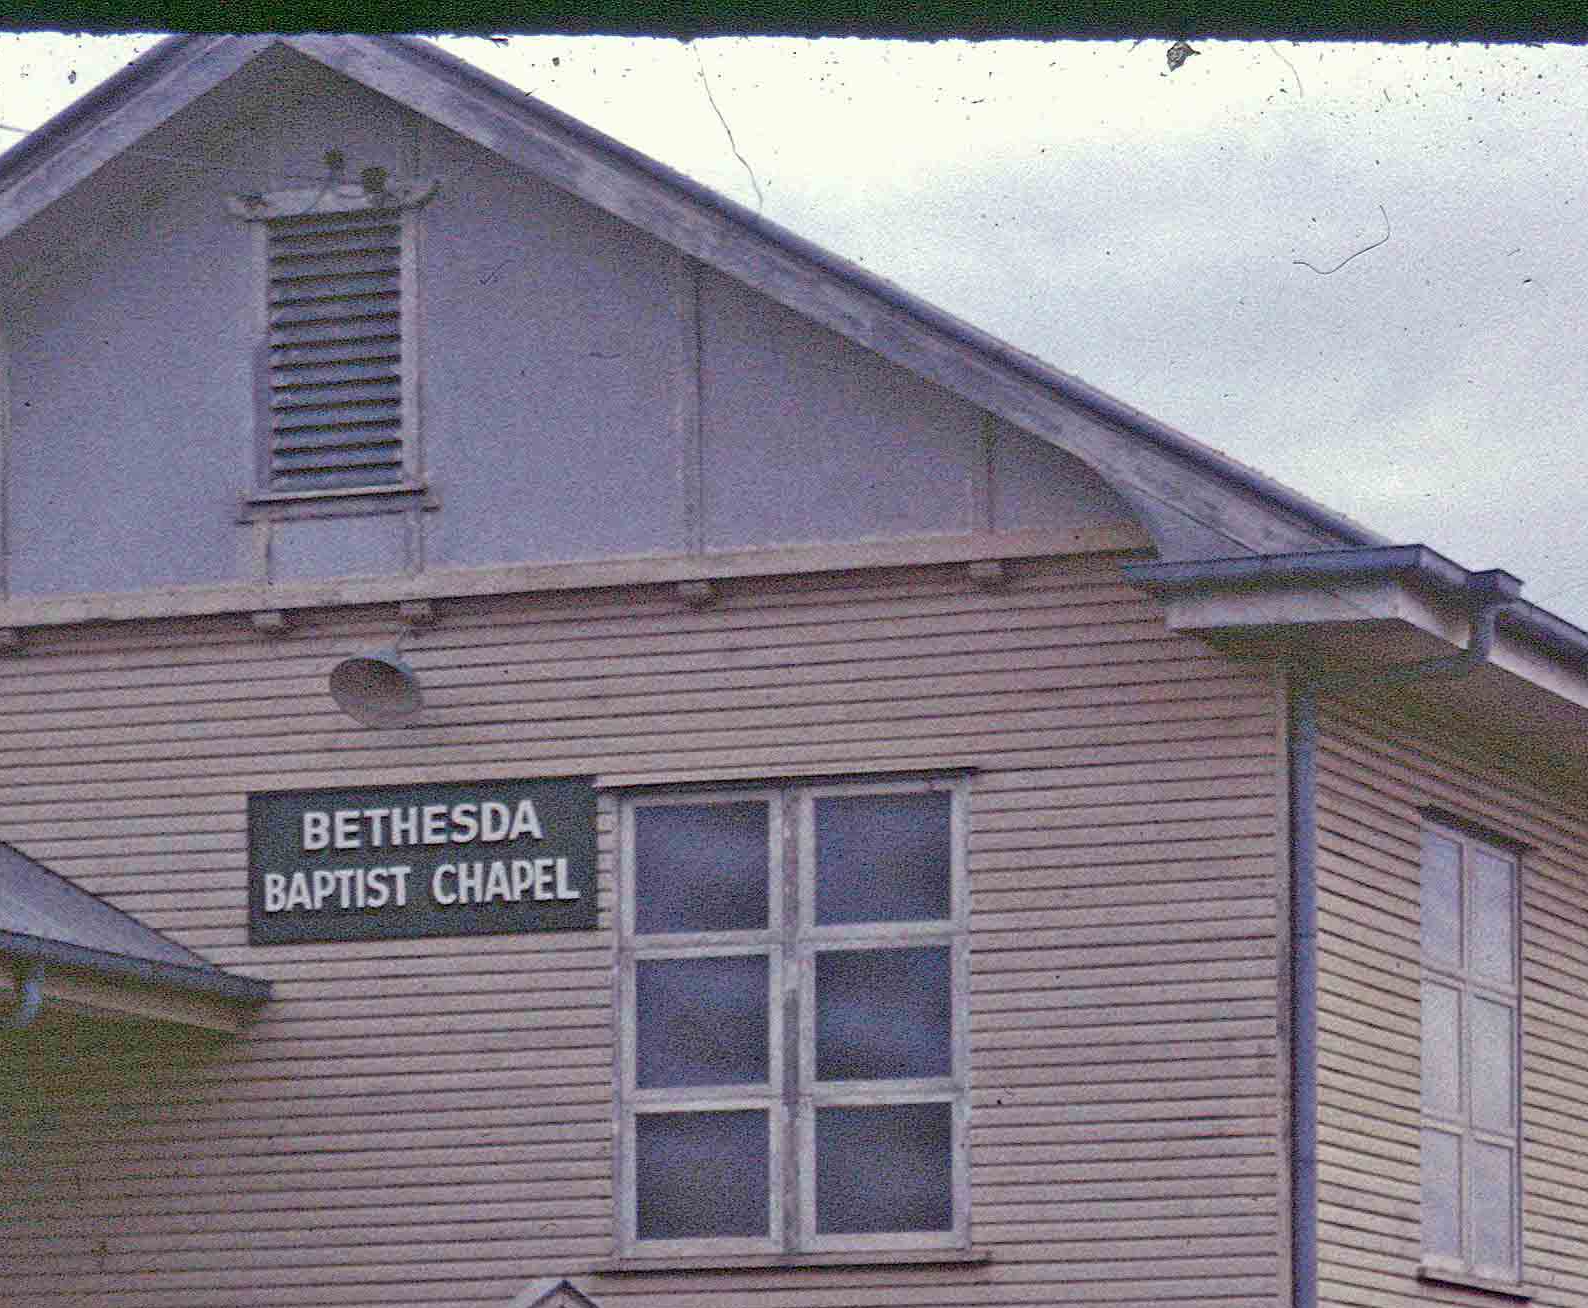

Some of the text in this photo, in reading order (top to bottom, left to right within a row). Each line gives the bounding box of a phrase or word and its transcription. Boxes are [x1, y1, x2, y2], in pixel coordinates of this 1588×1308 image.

[303, 800, 543, 852] BETHESDA
[264, 858, 580, 914] BAPTIST CHAPEL
